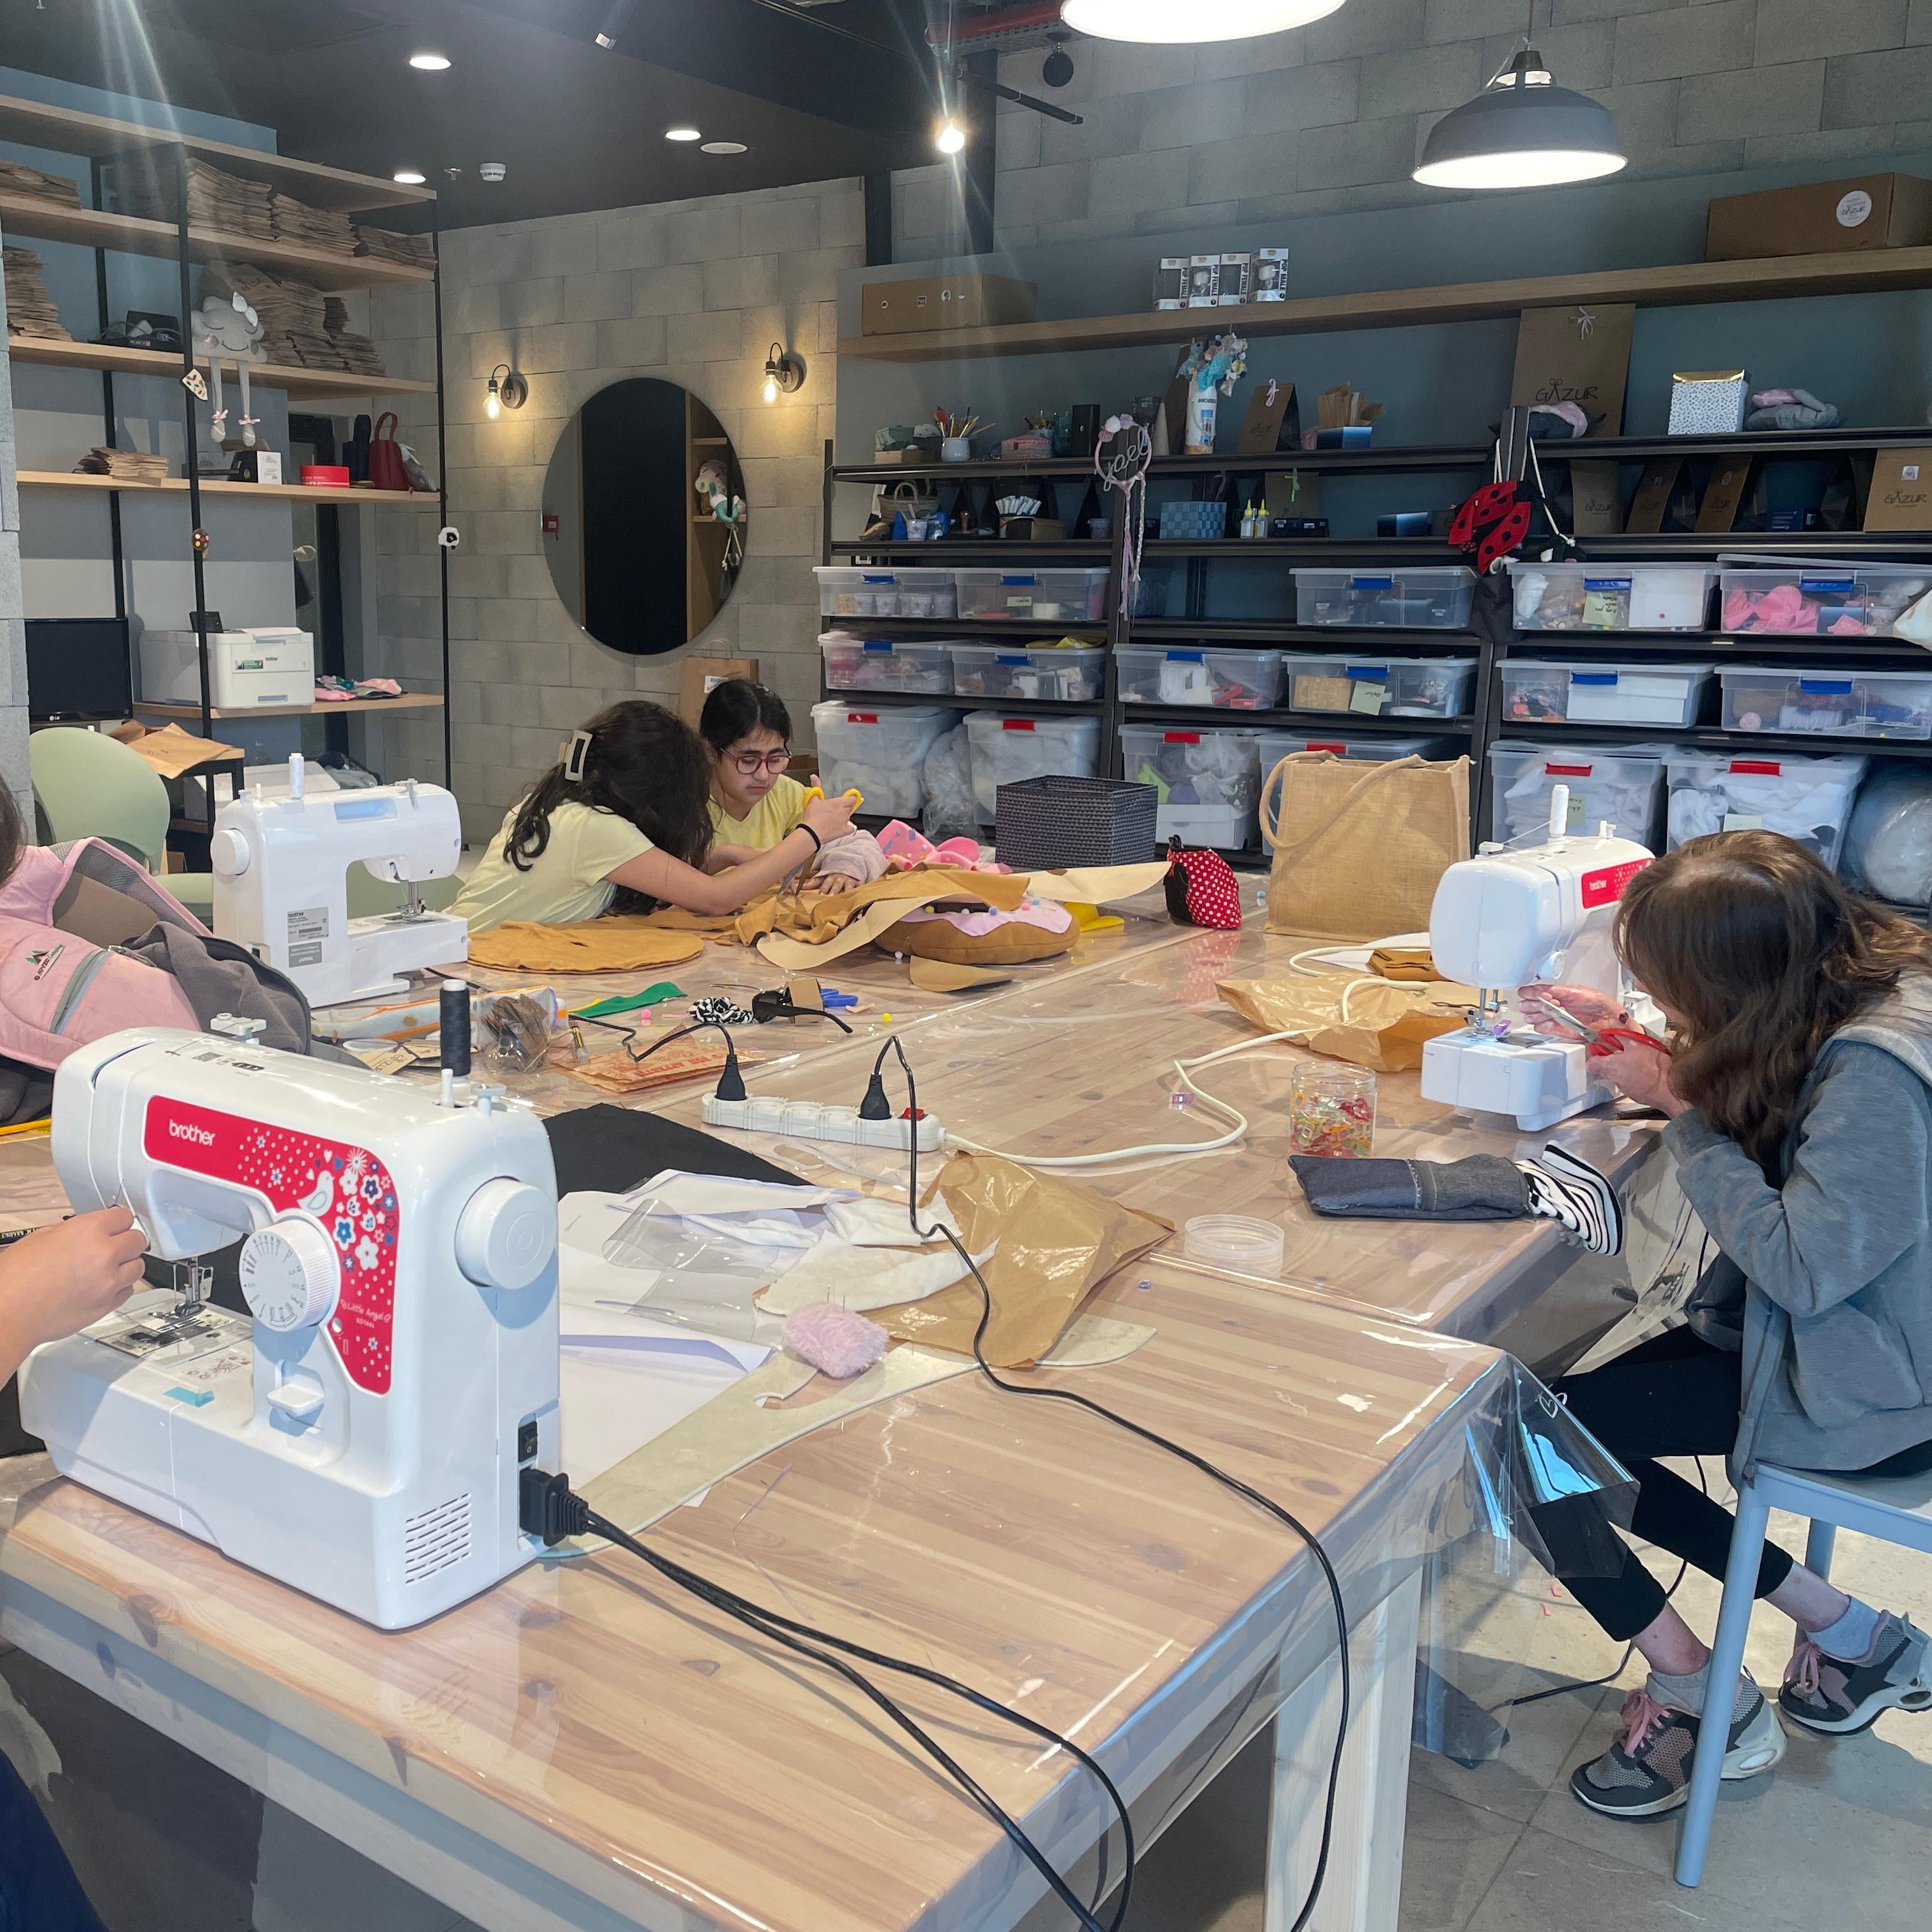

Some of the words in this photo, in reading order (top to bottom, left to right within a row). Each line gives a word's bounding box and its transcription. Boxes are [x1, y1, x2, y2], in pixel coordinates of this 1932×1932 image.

[1535, 378, 1598, 402] GAZUR
[1885, 489, 1928, 504] GAZUR
[169, 1119, 216, 1147] brother
[347, 1302, 364, 1314] Little
[366, 1308, 384, 1322] Angel
